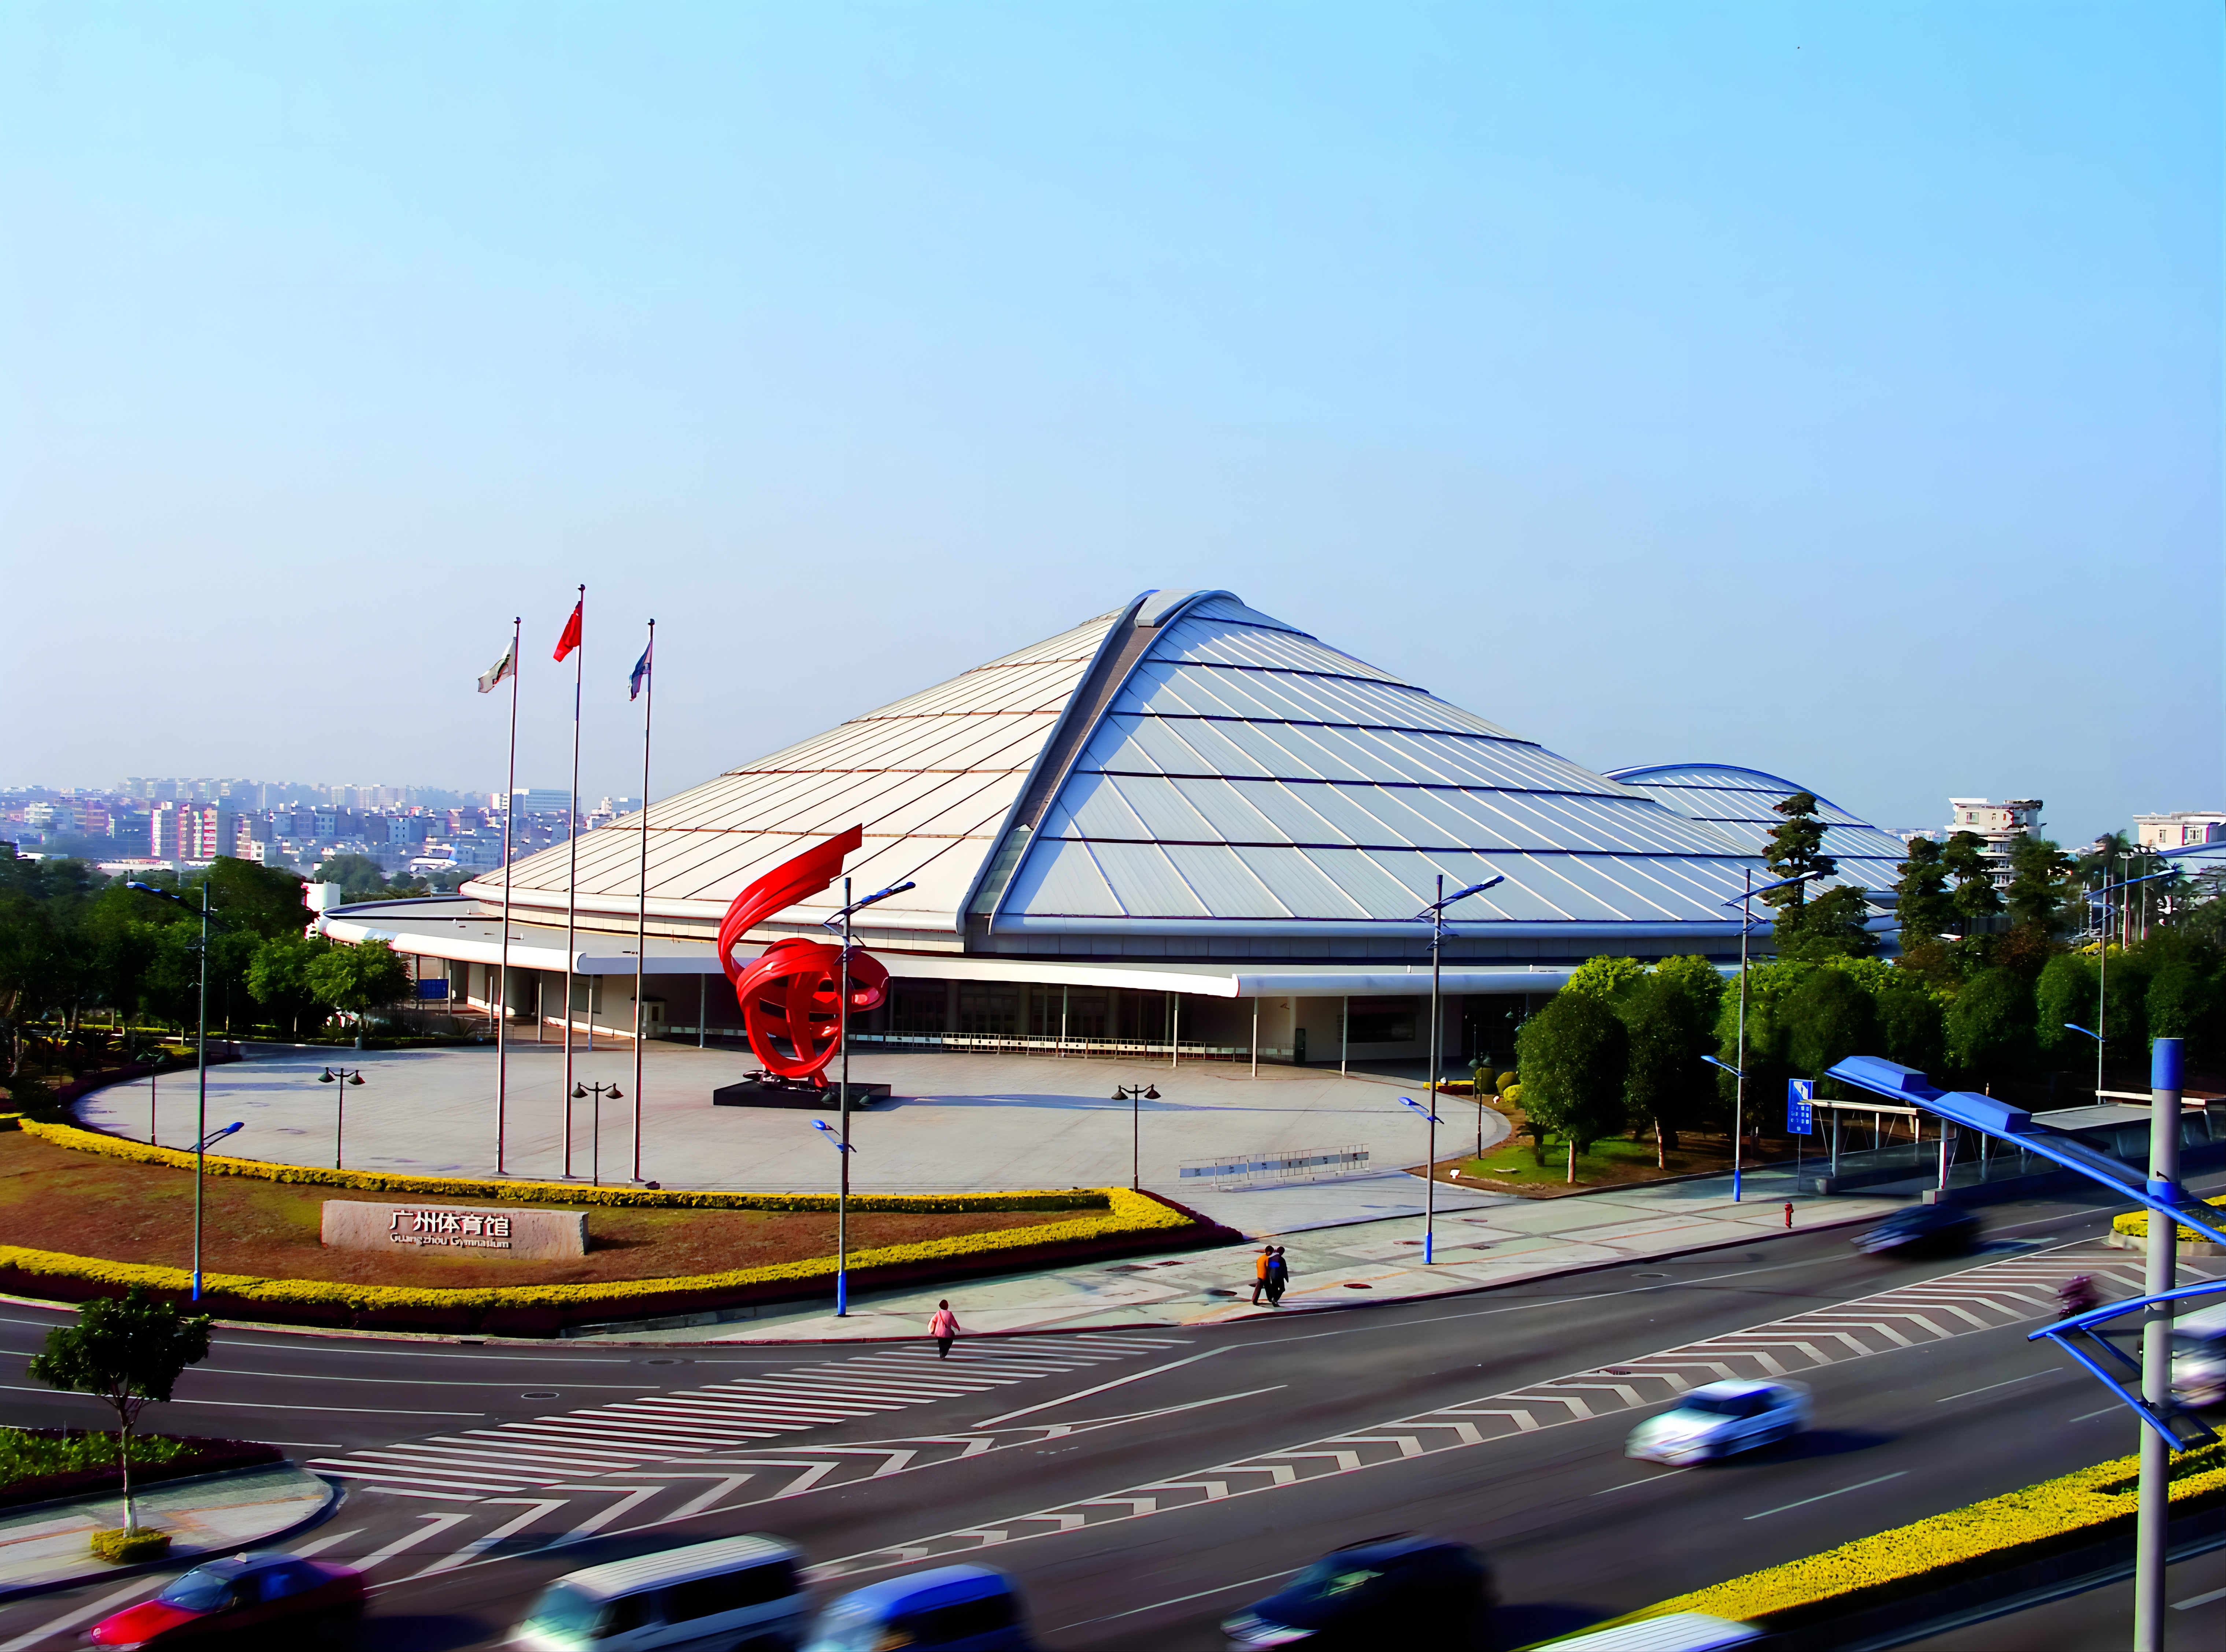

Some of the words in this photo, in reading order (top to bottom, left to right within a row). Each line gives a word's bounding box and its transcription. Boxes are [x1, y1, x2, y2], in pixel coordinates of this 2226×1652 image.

[389, 1210, 509, 1236] 广州体育馆
